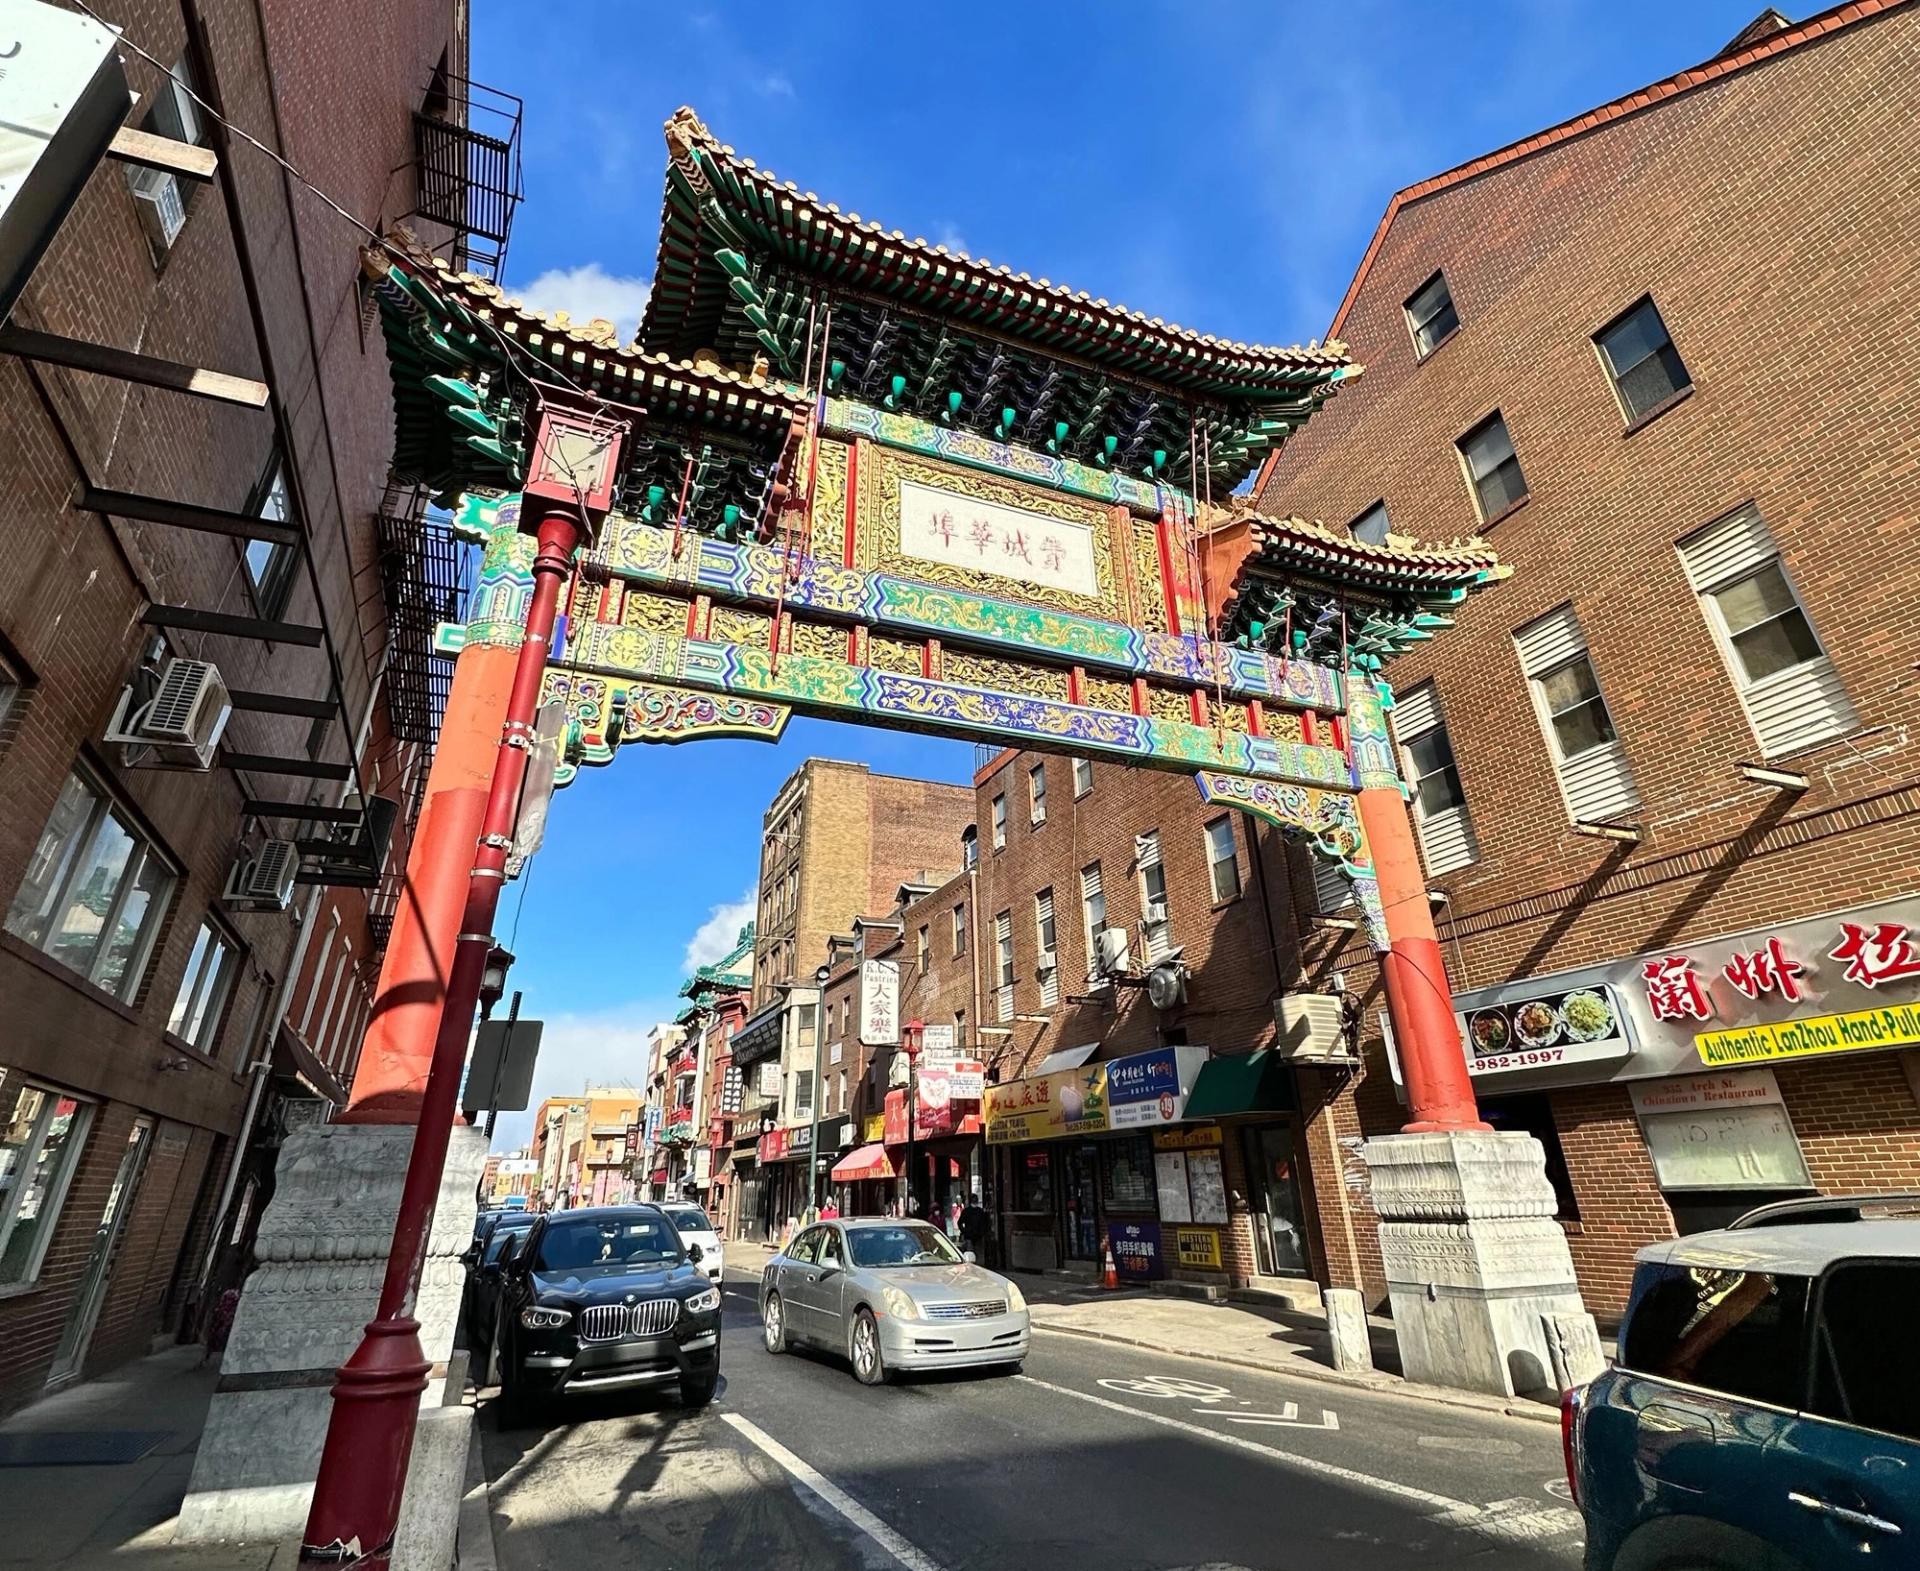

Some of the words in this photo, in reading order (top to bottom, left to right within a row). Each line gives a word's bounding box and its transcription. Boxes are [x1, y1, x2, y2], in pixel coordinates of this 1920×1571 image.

[869, 983, 891, 1033] 大家樂
[1704, 1029, 1772, 1062] Authentic
[1770, 1023, 1839, 1052] LanZhou
[1692, 1080, 1716, 1091] Arch
[1721, 1079, 1737, 1089] St.
[1703, 1087, 1767, 1102] Restaurant
